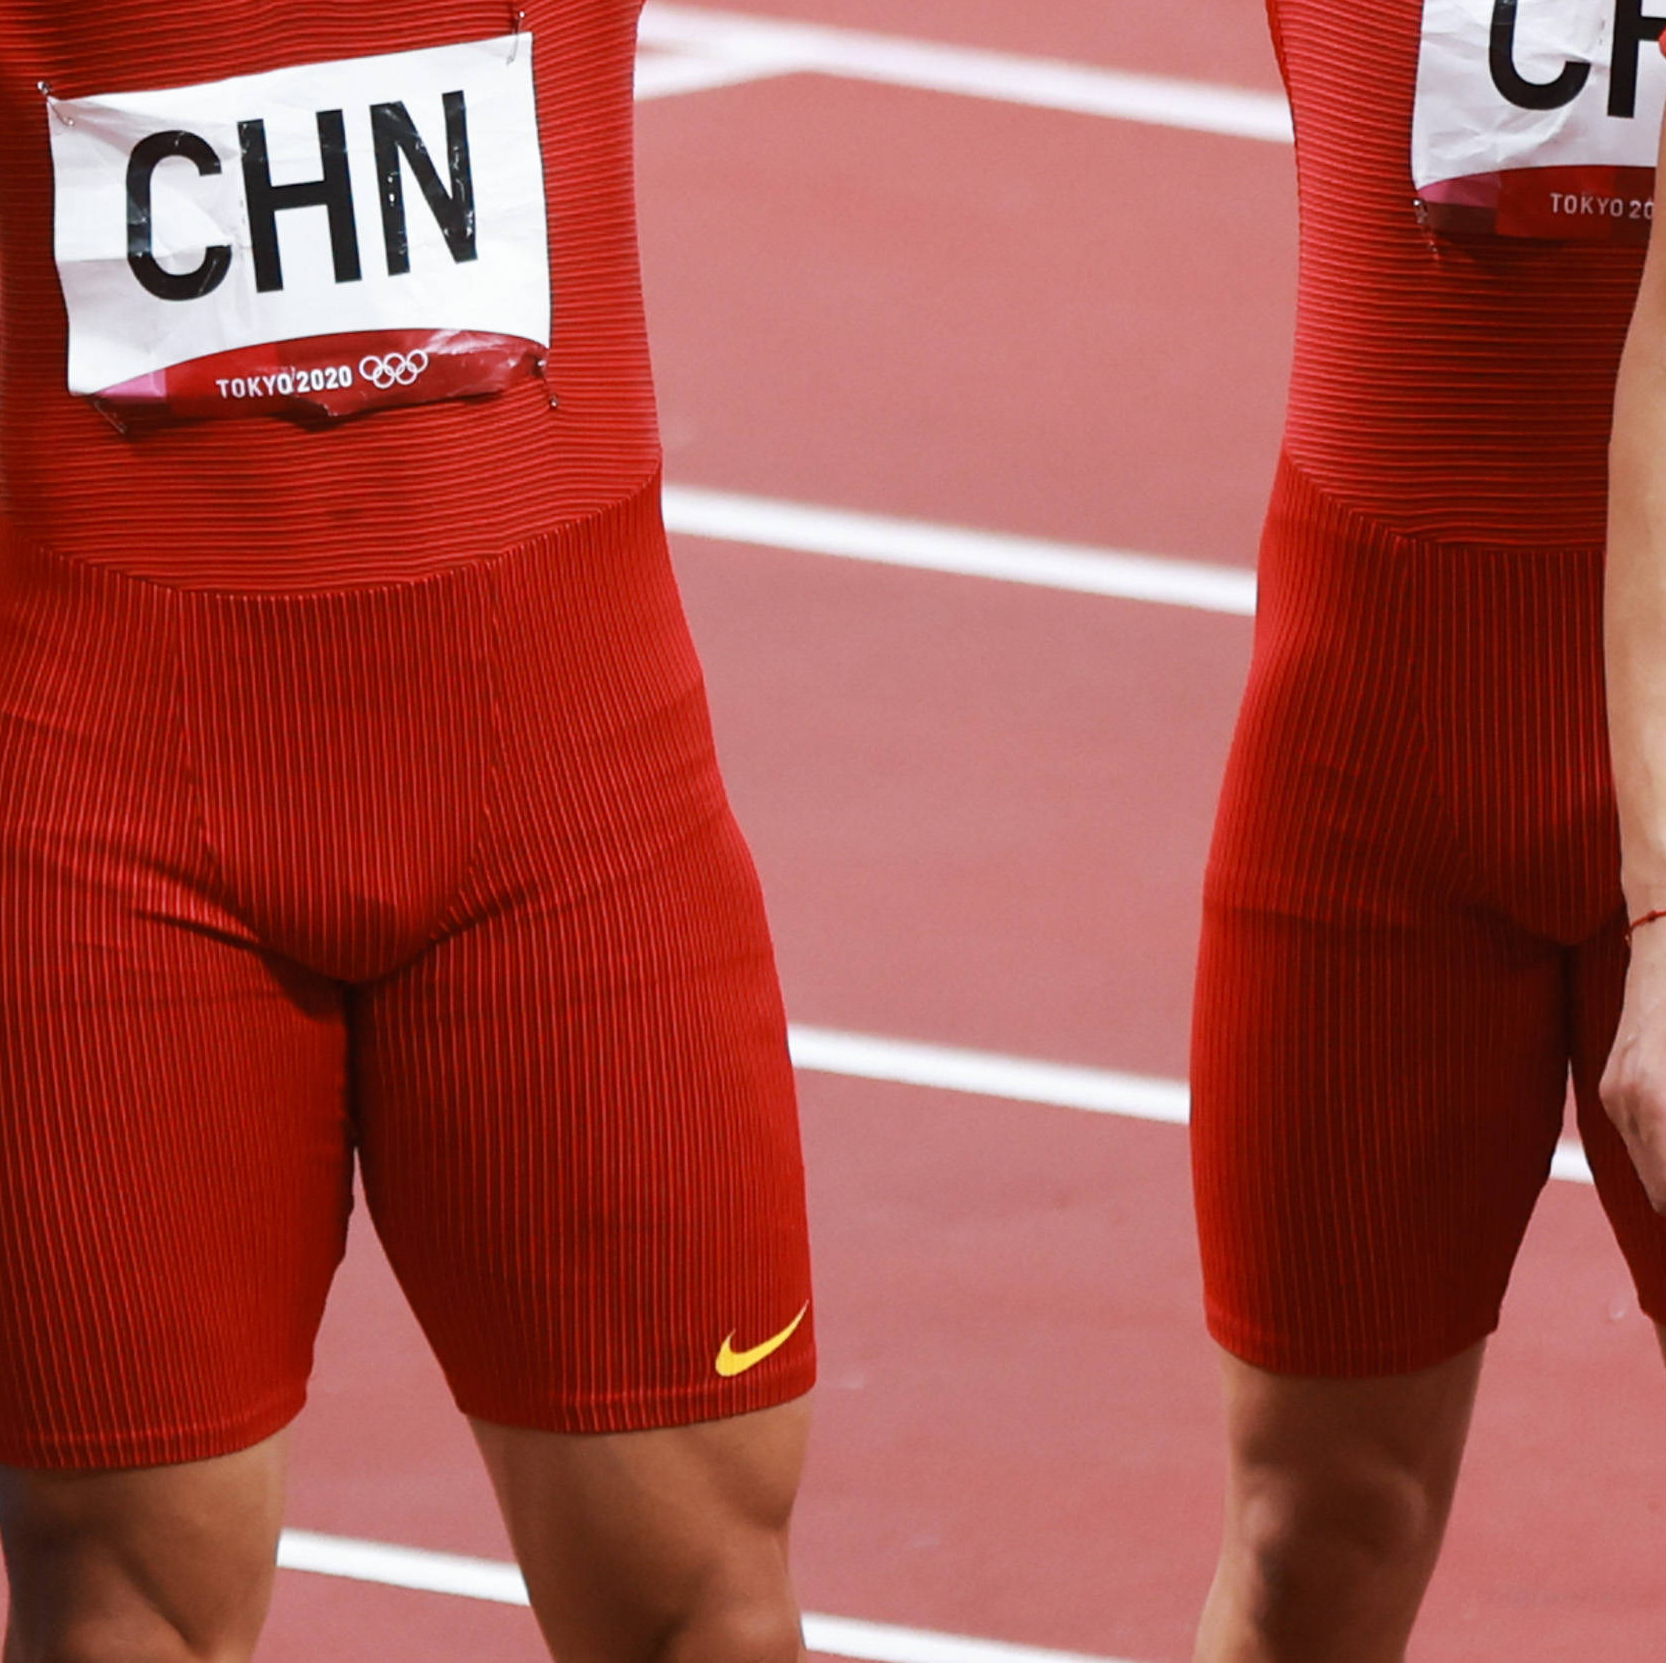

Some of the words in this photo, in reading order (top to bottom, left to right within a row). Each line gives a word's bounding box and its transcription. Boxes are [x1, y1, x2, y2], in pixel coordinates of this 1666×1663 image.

[125, 90, 477, 301] CHN
[1549, 192, 1623, 218] TOKYO
[1628, 199, 1655, 220] 20
[215, 372, 295, 399] TOKYO
[296, 365, 353, 394] 2020
